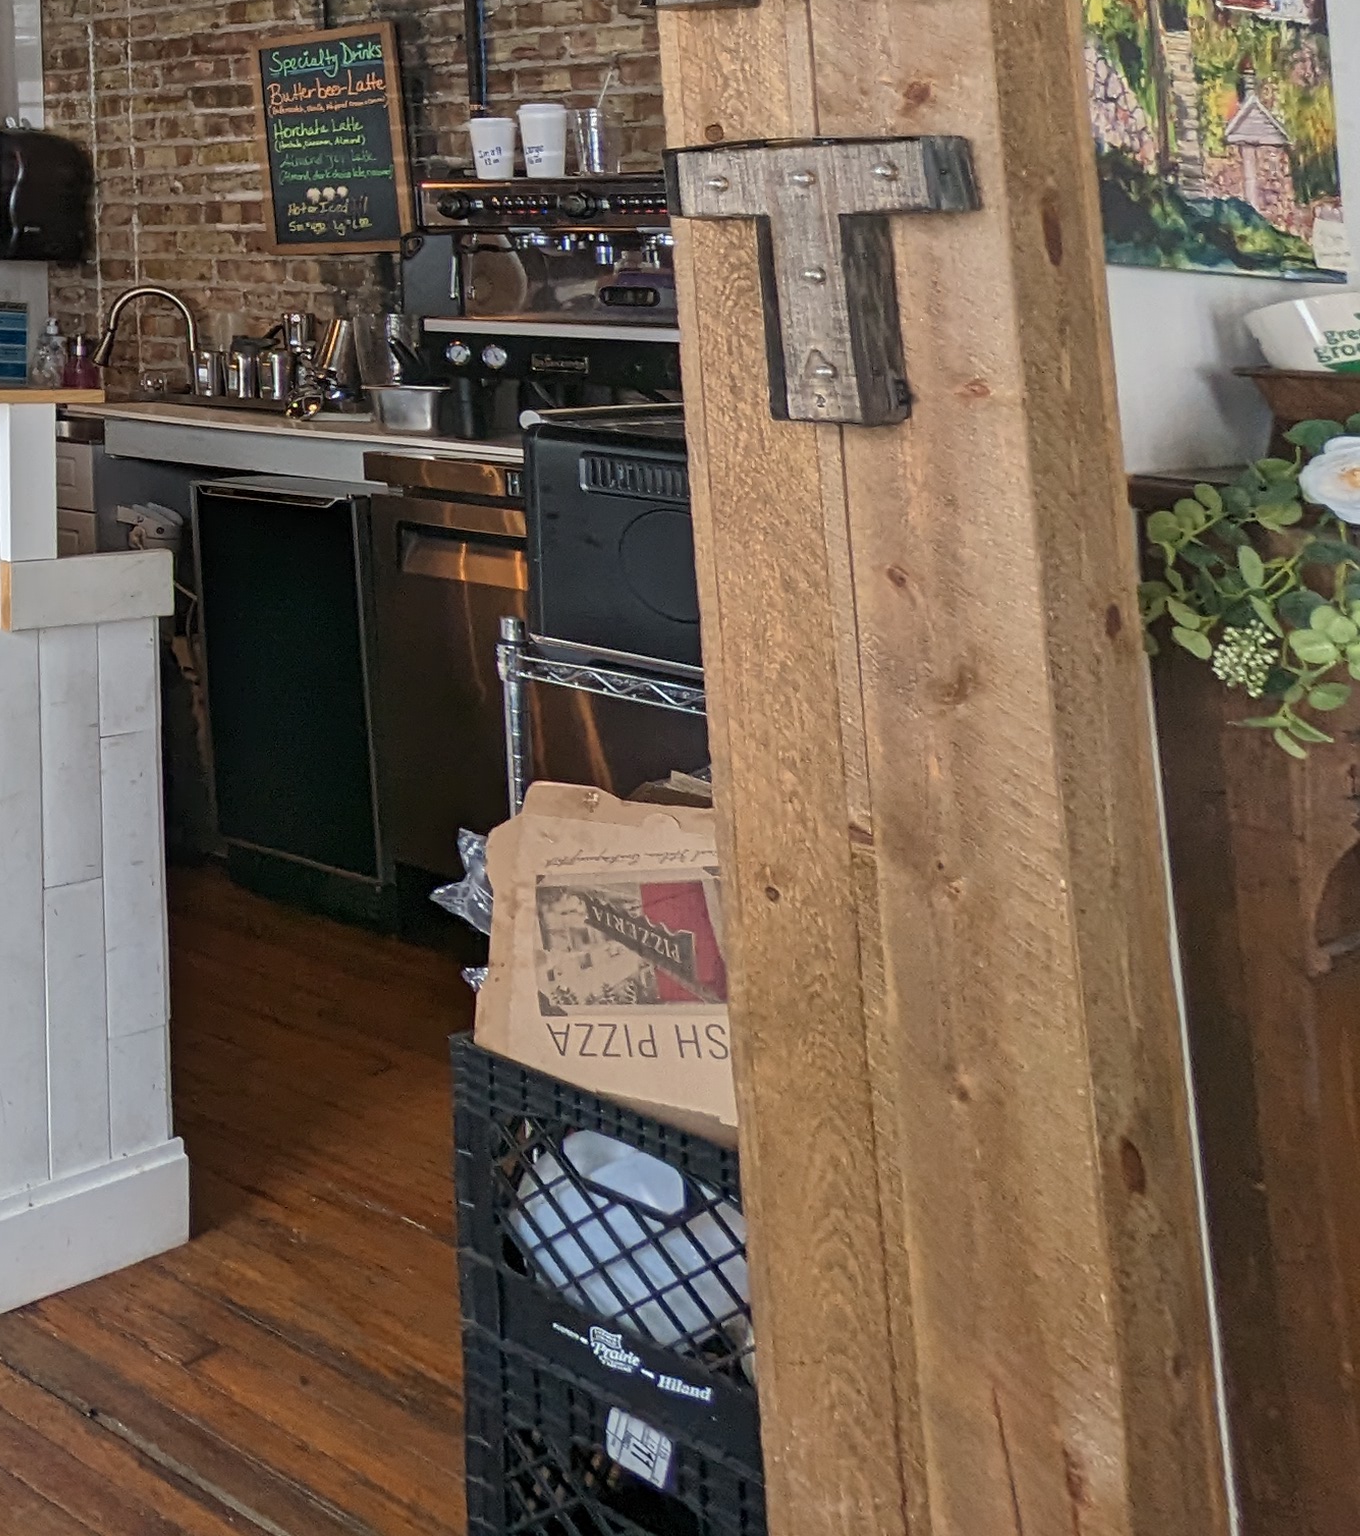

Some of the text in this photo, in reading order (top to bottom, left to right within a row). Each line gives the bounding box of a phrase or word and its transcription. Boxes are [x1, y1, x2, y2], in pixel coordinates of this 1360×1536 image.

[269, 41, 383, 78] Specialty Drinks
[347, 69, 387, 95] Latte
[331, 116, 364, 133] Latte
[1324, 329, 1360, 346] gre
[591, 906, 682, 964] PIZZERIA
[546, 1023, 659, 1059] PIZZA
[657, 1373, 713, 1402] Hiland
